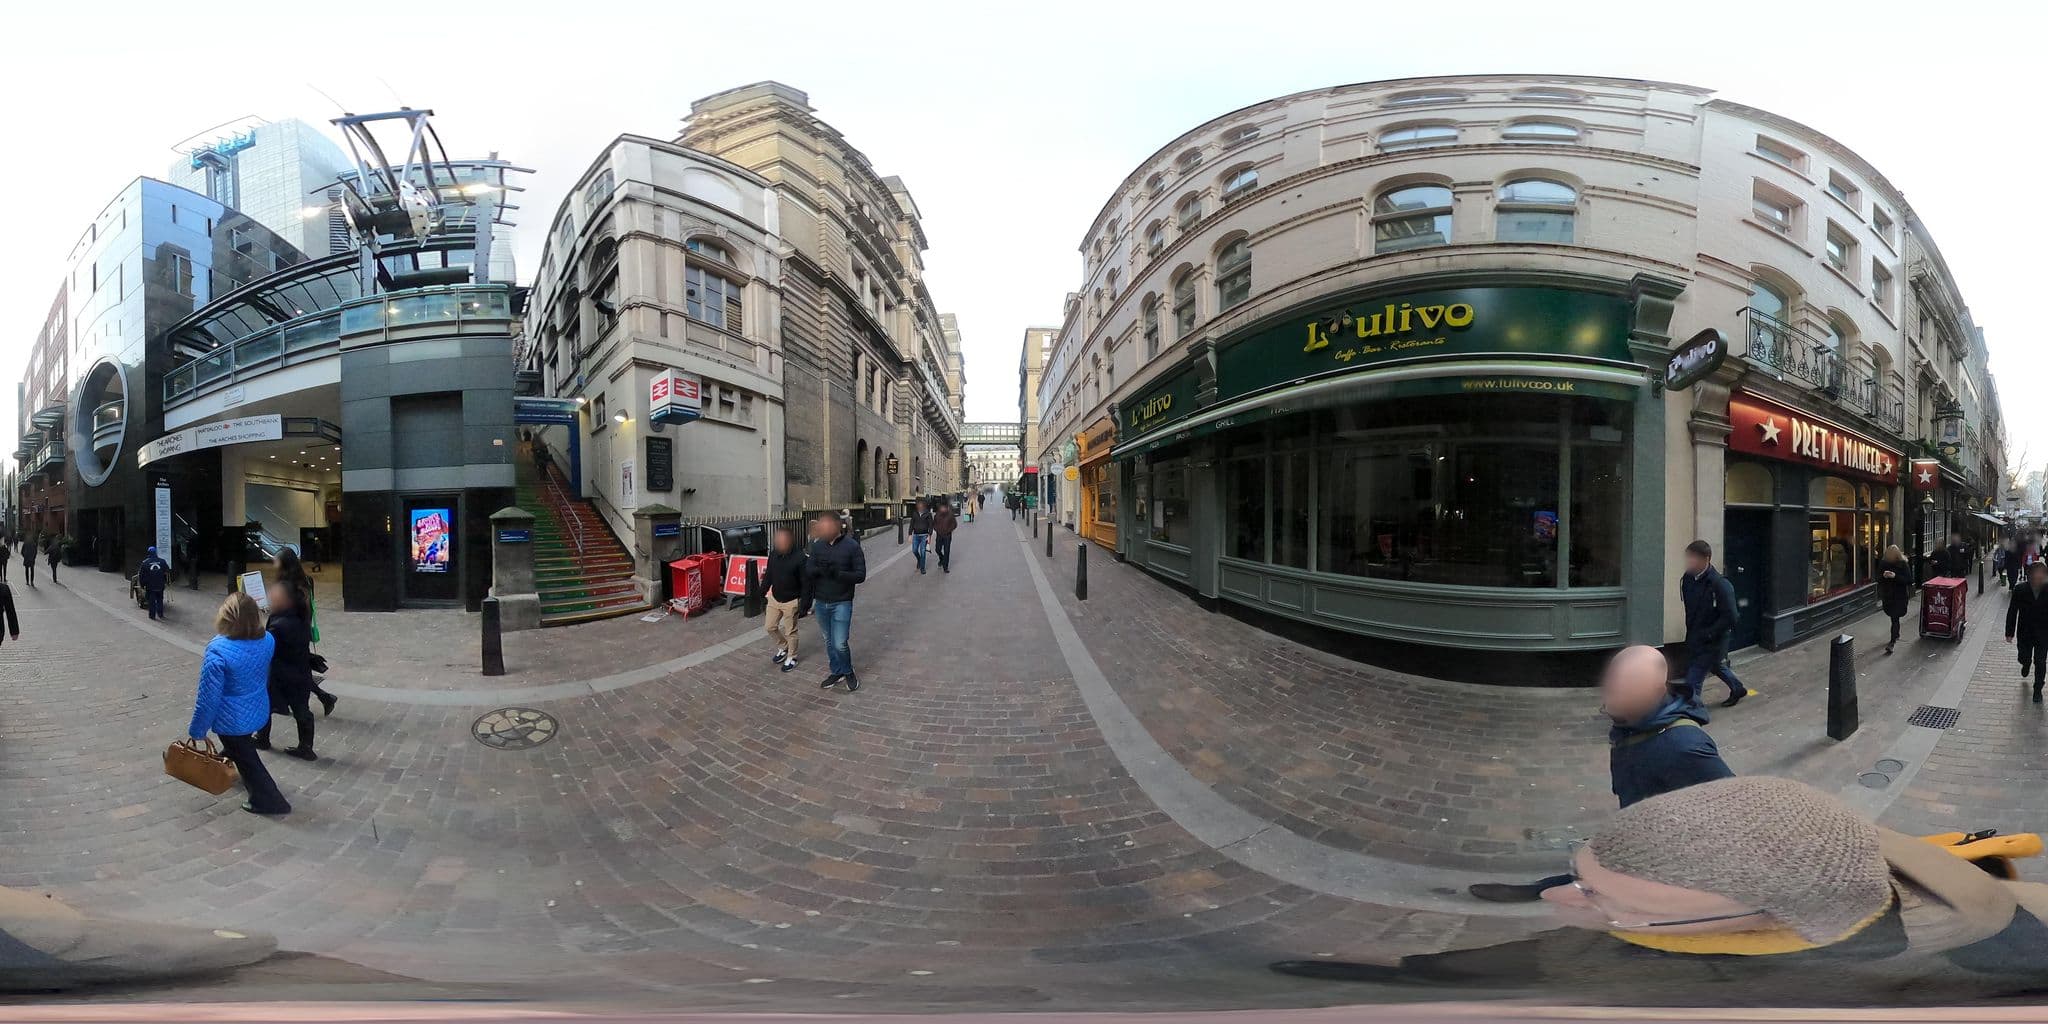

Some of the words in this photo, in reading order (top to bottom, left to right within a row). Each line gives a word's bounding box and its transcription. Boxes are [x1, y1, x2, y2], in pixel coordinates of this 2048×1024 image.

[244, 417, 279, 427] SOUTHBANK
[1216, 420, 1234, 430] GRILL
[218, 434, 237, 443] ARCHES
[239, 431, 266, 441] SHOPPING
[1792, 417, 1828, 460] PRET
[1831, 432, 1840, 464] A
[1844, 436, 1881, 475] MANGER
